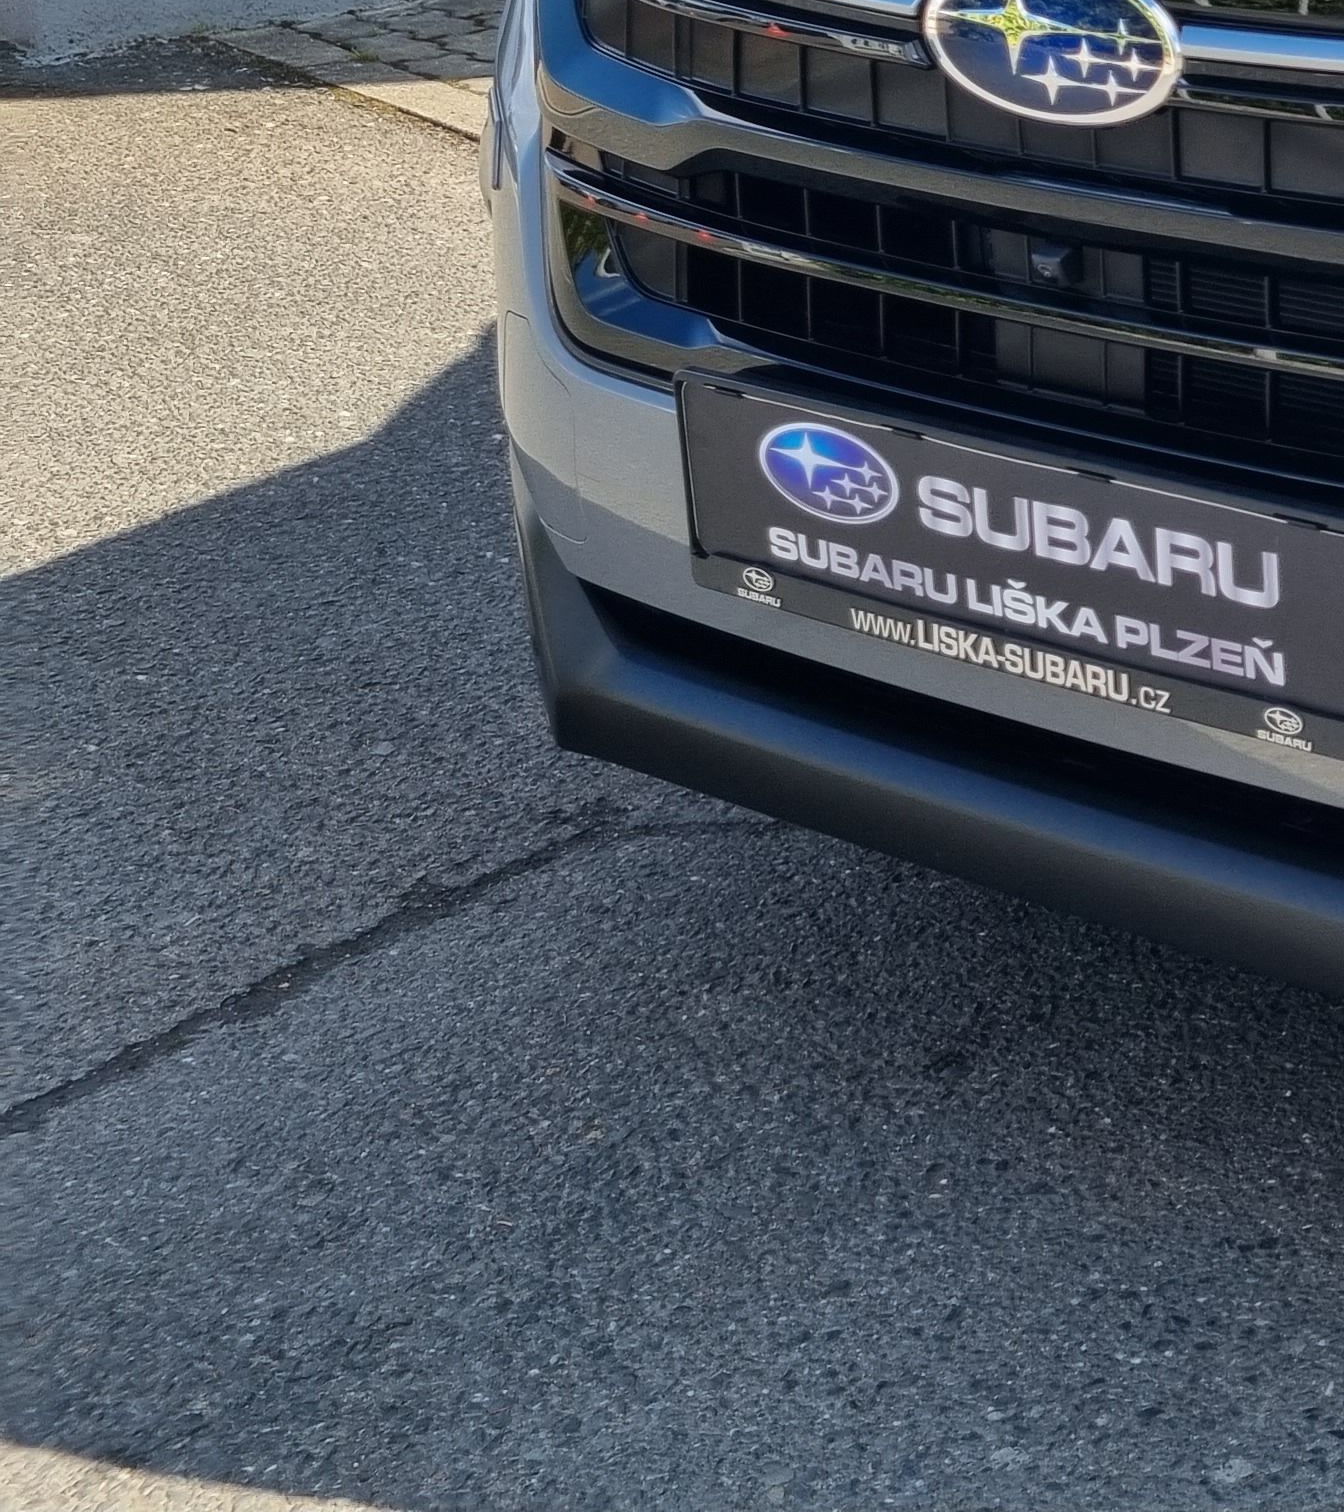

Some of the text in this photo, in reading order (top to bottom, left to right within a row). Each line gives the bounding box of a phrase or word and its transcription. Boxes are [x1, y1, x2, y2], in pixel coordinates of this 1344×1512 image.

[737, 587, 782, 608] SUBARU
[917, 474, 1281, 611] SUBARU
[767, 525, 1287, 689] SUBARU LIŠKA PLZEŇ
[850, 606, 1172, 716] www.LISKA-SUBARU.cz
[1257, 729, 1312, 752] SUBARU
